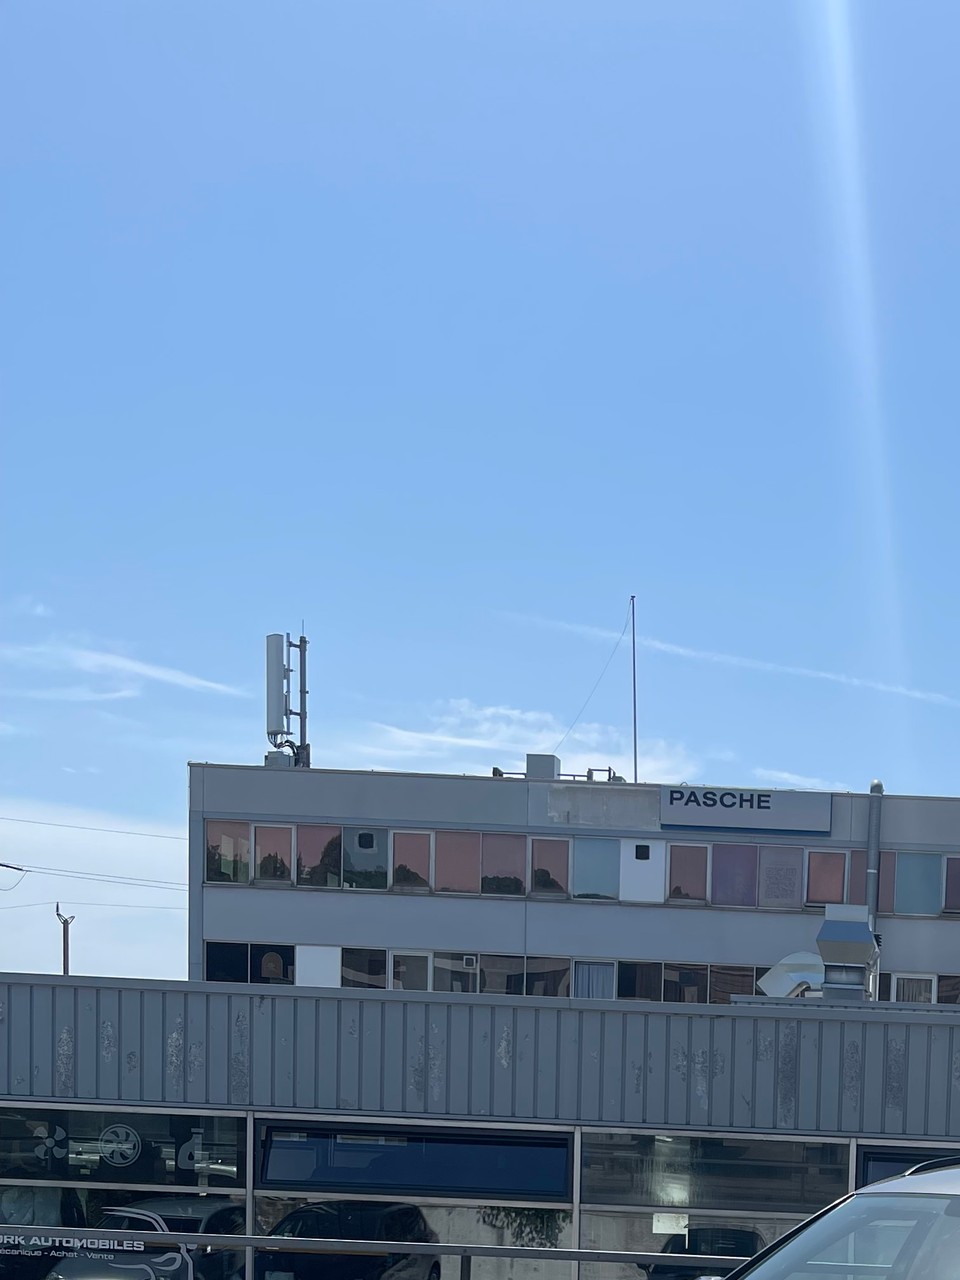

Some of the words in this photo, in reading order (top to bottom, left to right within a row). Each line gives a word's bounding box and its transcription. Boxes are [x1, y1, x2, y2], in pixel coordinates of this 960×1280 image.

[669, 790, 772, 810] PASCHE
[29, 1236, 145, 1251] AUTOMOBILES
[49, 1249, 78, 1258] Achat
[86, 1251, 115, 1260] Vente
